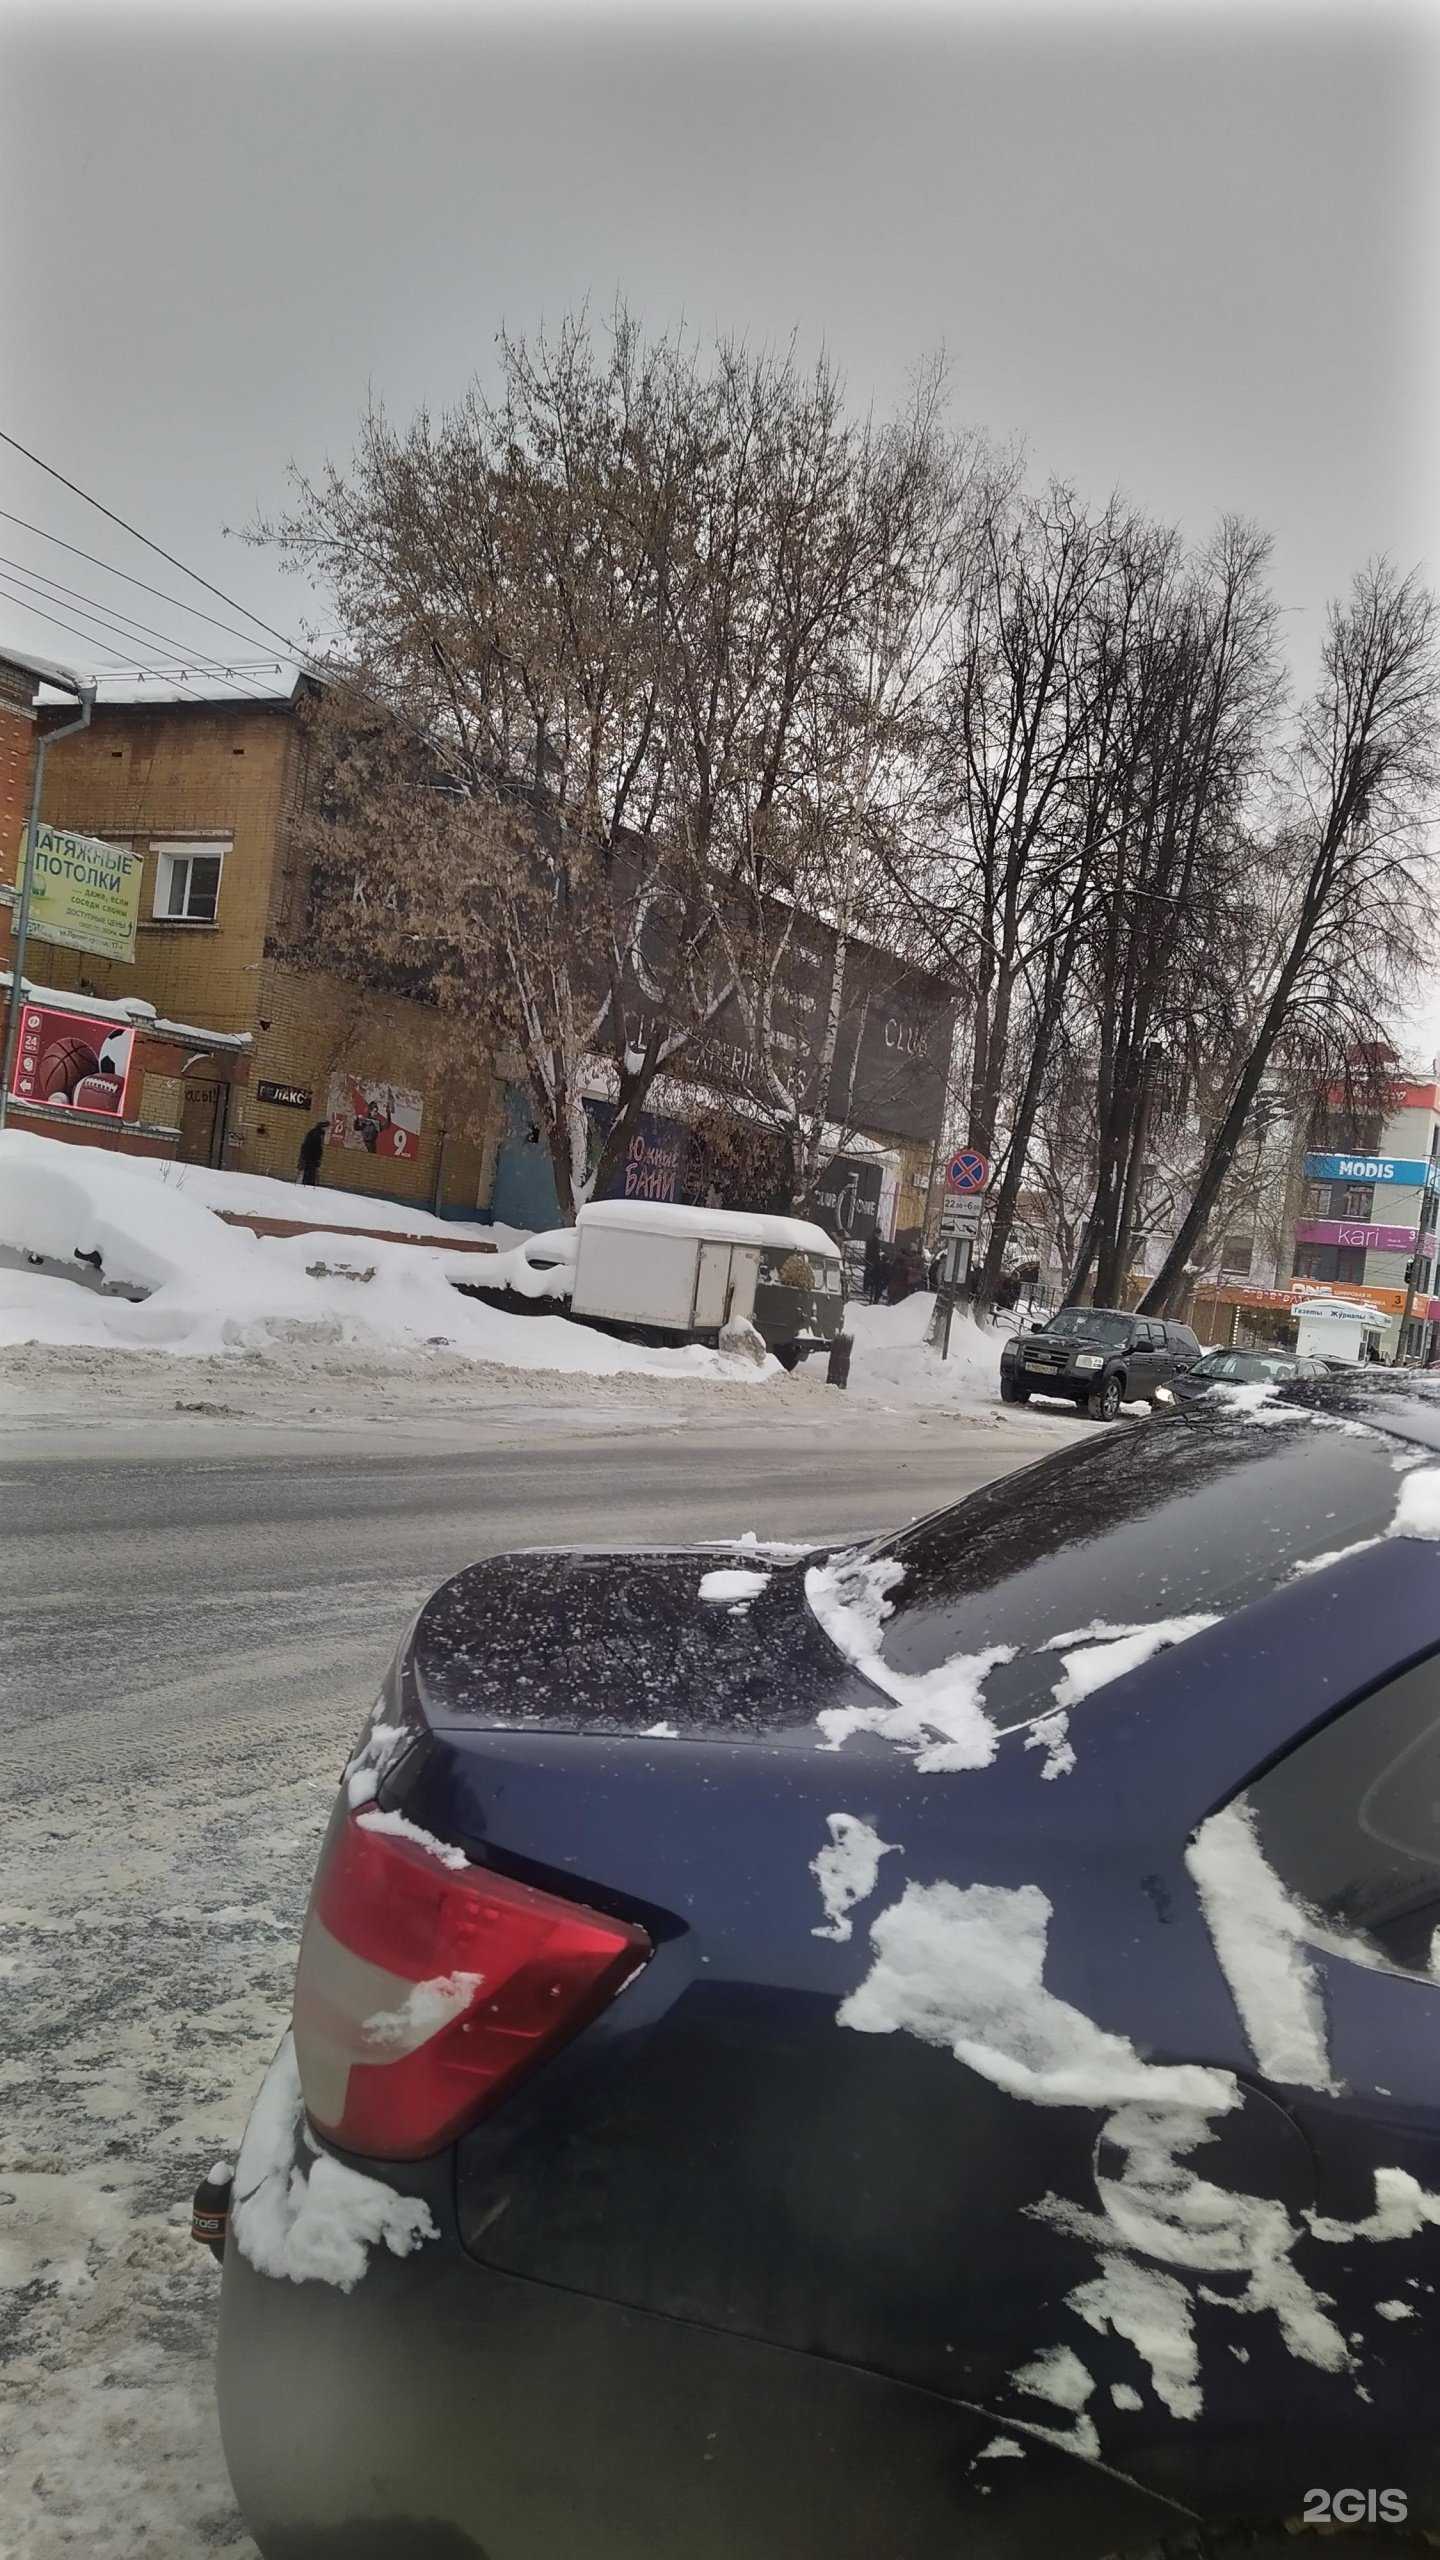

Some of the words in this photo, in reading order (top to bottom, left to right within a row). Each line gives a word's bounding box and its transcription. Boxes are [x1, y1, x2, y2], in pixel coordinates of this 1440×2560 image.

[36, 853, 120, 893] ПОТОЛКИ
[394, 1130, 407, 1155] 9
[1339, 1161, 1394, 1178] MODIS
[625, 1162, 676, 1201] БАНИ
[1337, 1226, 1380, 1247] kari
[1409, 1230, 1416, 1240] 3
[1394, 1295, 1402, 1304] 3
